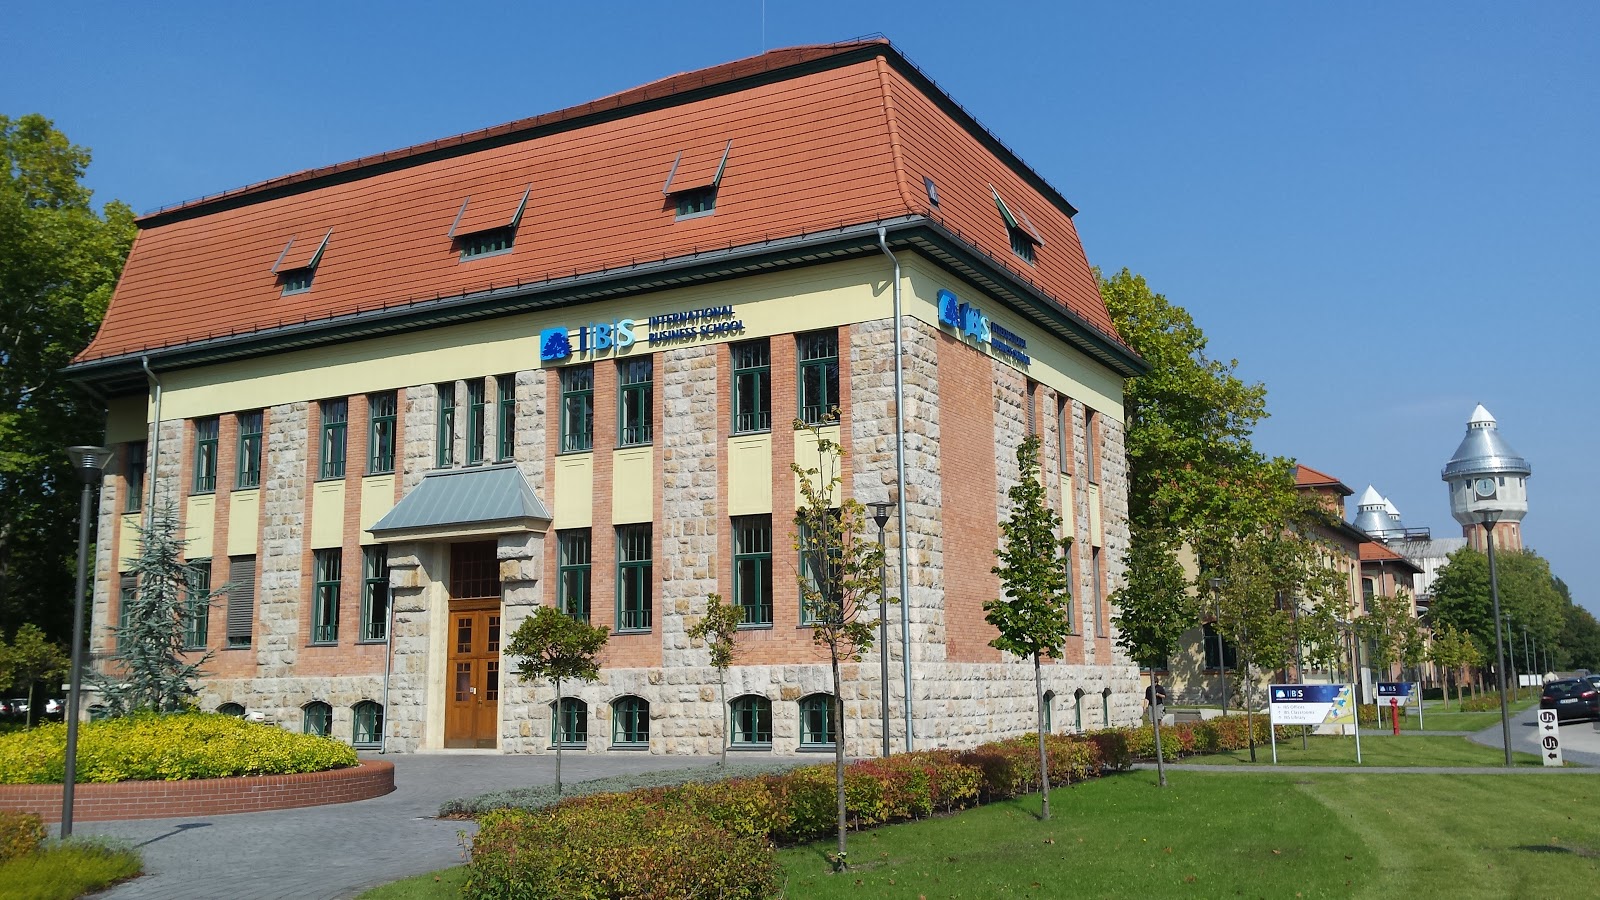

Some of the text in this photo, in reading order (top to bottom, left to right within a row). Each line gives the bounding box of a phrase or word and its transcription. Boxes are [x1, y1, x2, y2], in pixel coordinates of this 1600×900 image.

[649, 305, 735, 328] INTERNATIONAL
[649, 319, 745, 342] BUSINESS SCHOOL
